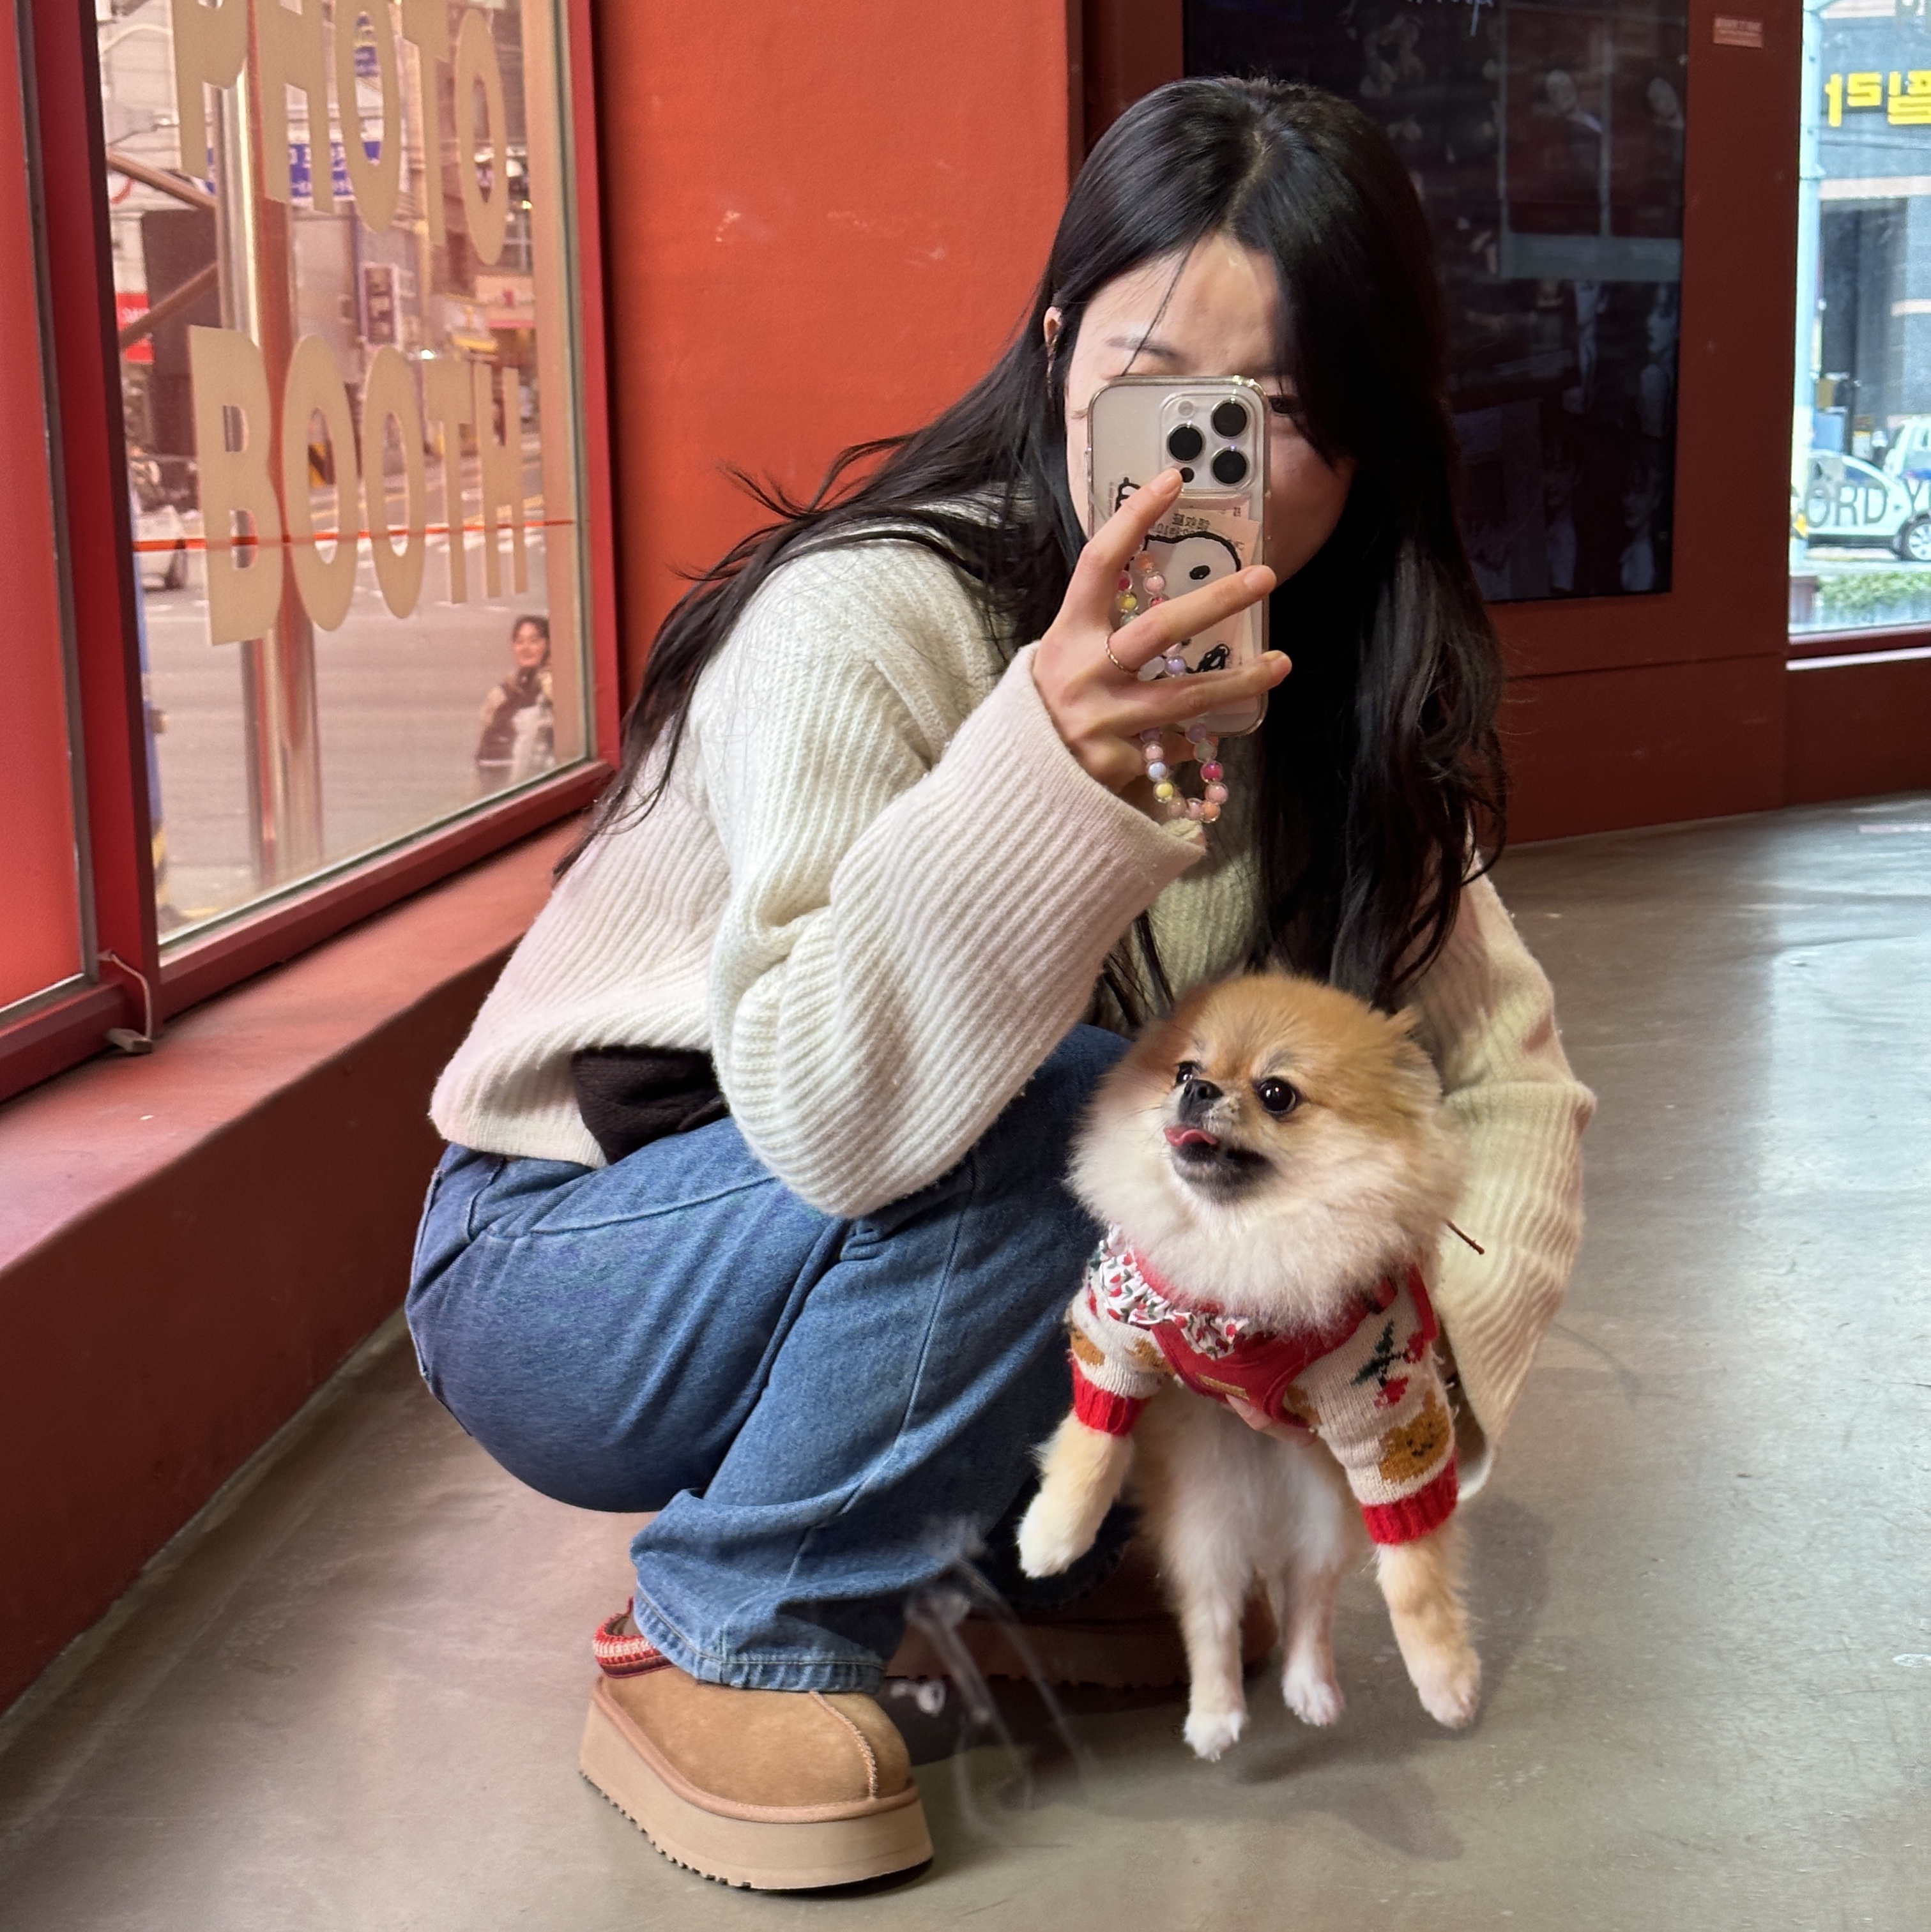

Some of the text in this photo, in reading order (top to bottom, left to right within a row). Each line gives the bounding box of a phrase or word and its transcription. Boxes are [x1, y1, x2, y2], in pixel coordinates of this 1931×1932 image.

[171, 0, 508, 266] PHOTO
[190, 325, 528, 646] BOOTH
[1792, 474, 1931, 528] ORD Y
